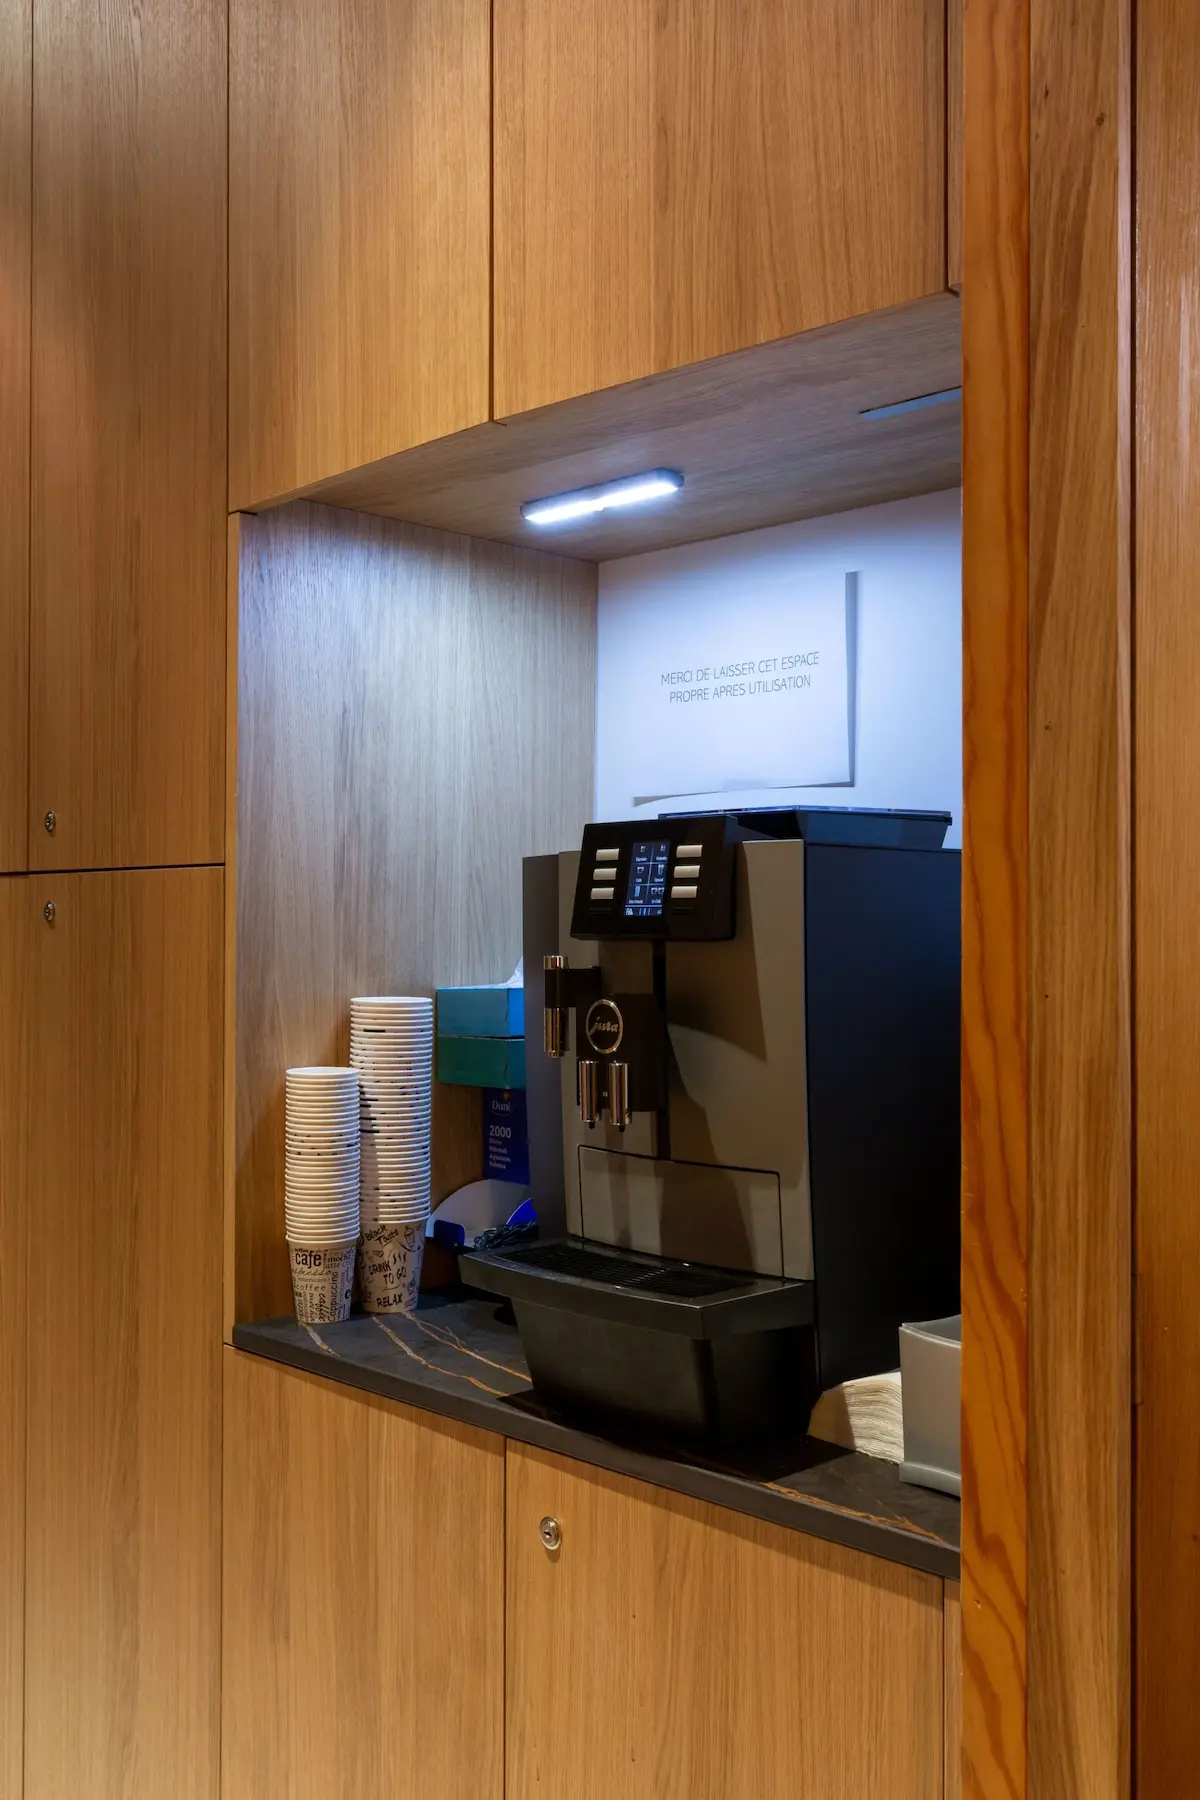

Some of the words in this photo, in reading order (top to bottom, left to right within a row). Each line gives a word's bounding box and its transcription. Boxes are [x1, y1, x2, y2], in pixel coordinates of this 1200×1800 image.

[661, 671, 693, 686] MERCI
[696, 668, 710, 682] DE
[713, 661, 755, 680] LAISSER
[757, 658, 778, 673] CET
[781, 651, 820, 670] ESPACE
[669, 687, 710, 704] PROPRE
[712, 683, 746, 700] APRES
[749, 674, 811, 695] UTILISATION
[589, 1017, 620, 1036] jura
[491, 1100, 511, 1112] Duni
[489, 1125, 512, 1139] 2000
[364, 1224, 388, 1241] Black
[368, 1260, 392, 1276] DRINK
[383, 1272, 395, 1285] TO
[396, 1266, 407, 1279] GO
[376, 1293, 403, 1308] RELAX
